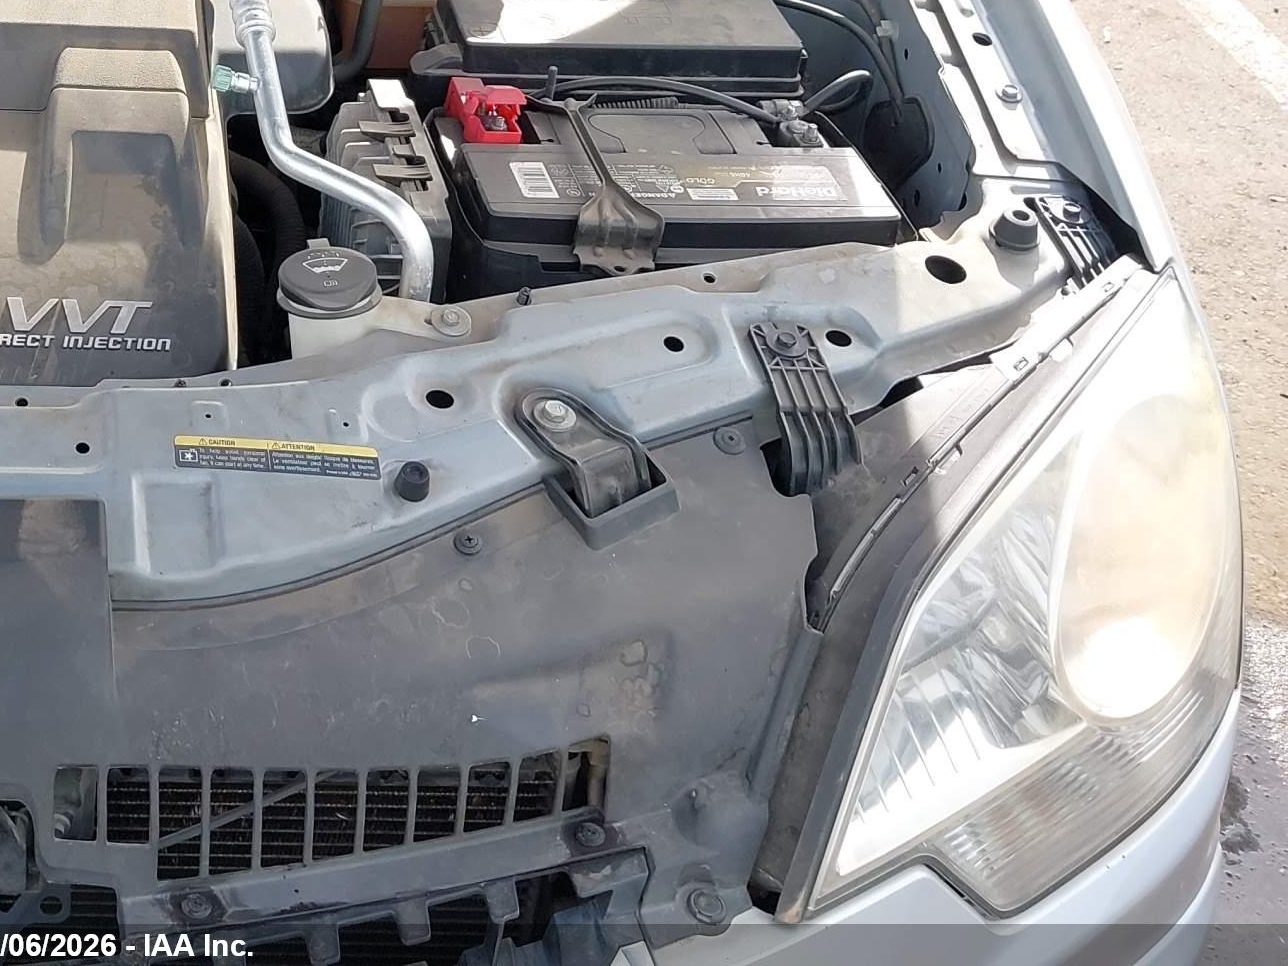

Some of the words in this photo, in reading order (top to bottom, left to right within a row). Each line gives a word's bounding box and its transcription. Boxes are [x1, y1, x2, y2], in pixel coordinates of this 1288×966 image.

[7, 296, 153, 334] VVT
[63, 335, 171, 351] INJECTION
[281, 443, 316, 451] ATTENTION
